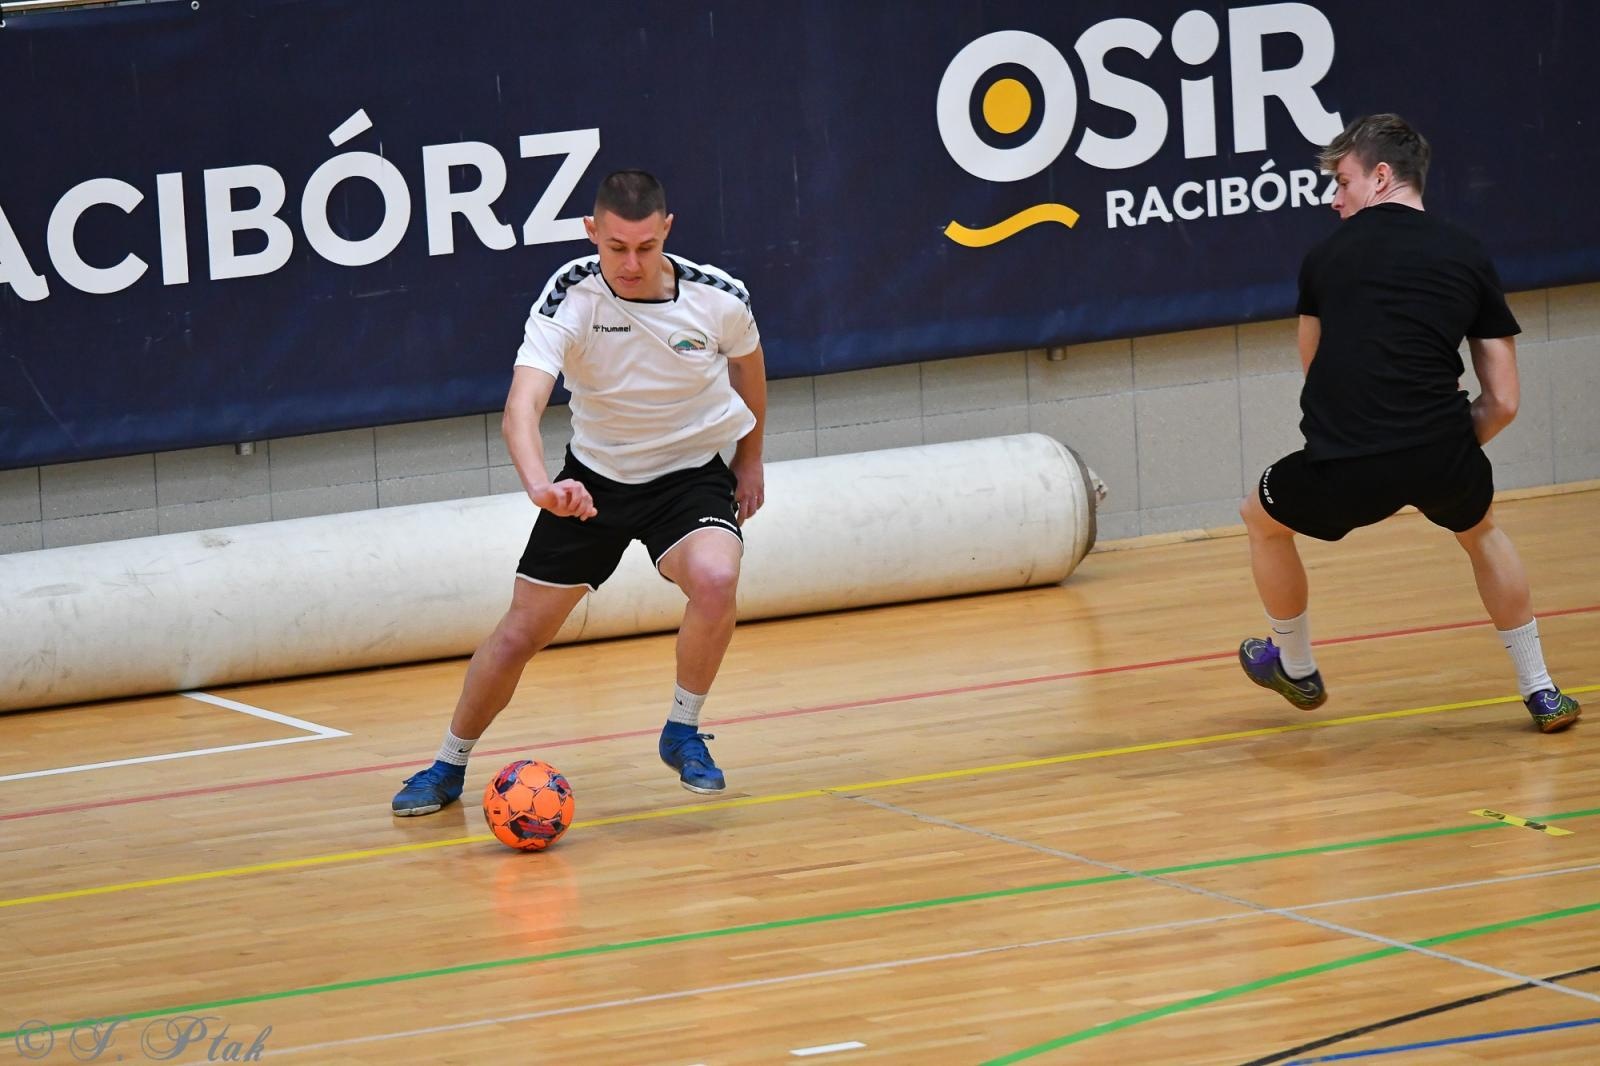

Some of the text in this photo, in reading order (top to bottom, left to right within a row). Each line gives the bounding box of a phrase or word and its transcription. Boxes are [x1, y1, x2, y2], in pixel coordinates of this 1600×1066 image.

[936, 2, 1344, 182] OSiR
[1106, 159, 1338, 228] RACIBÓRZ
[601, 324, 631, 333] hummel
